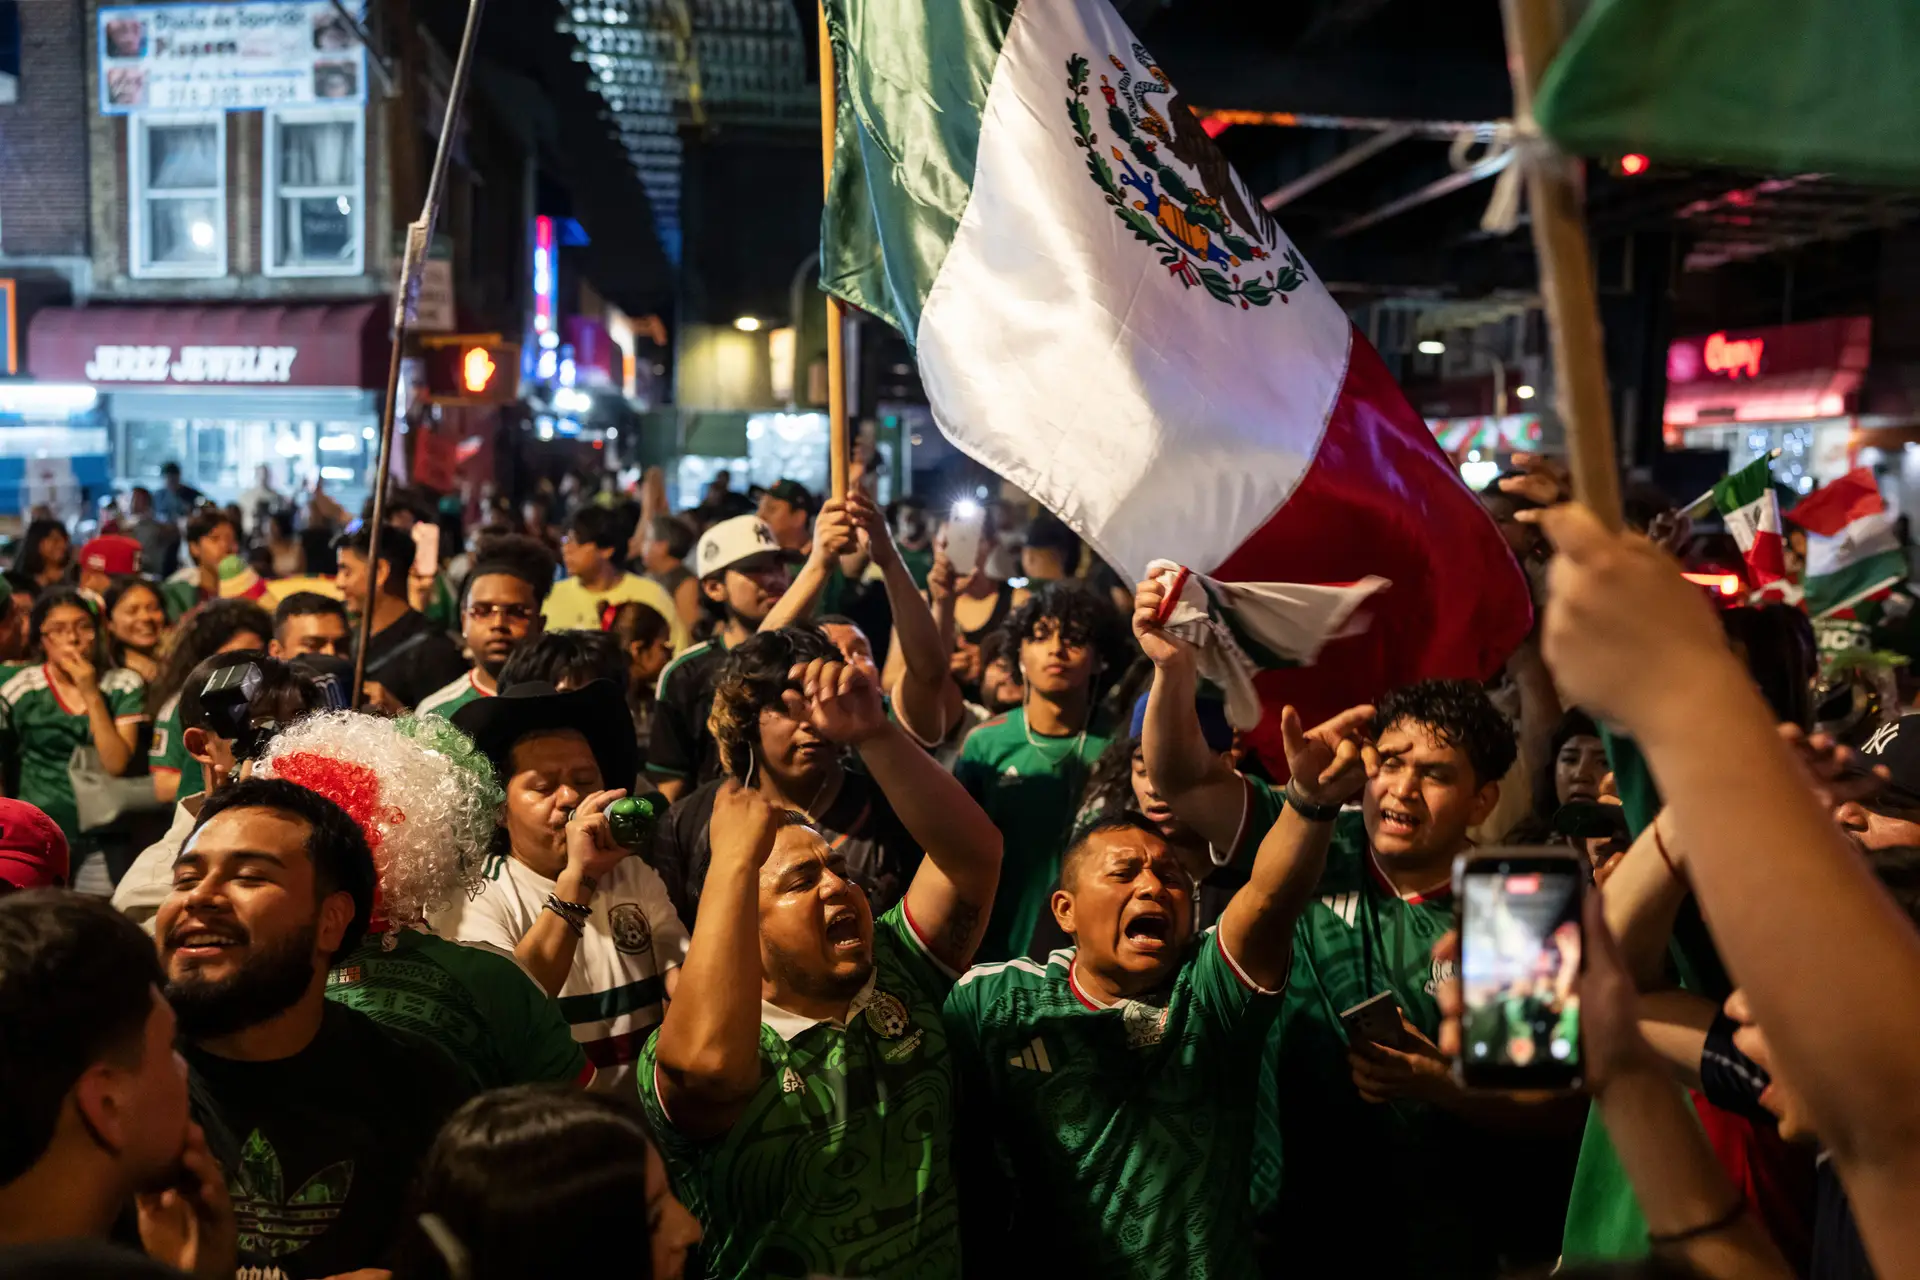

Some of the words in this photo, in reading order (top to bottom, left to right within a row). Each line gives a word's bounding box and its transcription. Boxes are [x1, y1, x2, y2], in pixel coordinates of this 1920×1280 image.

[86, 345, 171, 381] JEREZ
[171, 345, 297, 382] JEWELRY
[1861, 722, 1899, 755] NY
